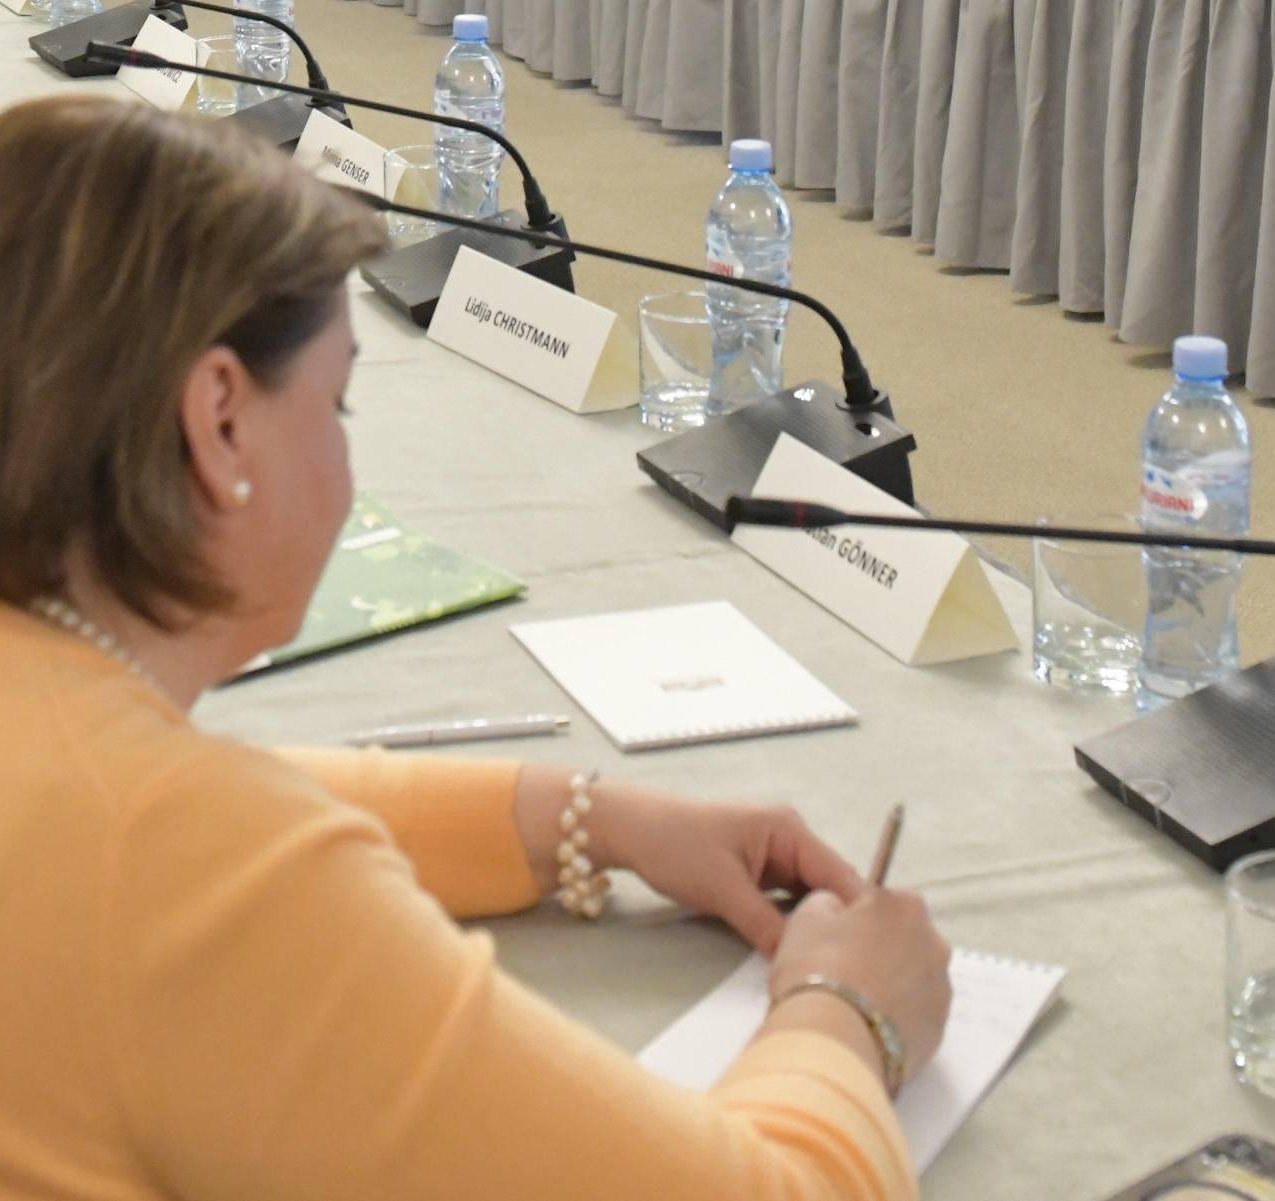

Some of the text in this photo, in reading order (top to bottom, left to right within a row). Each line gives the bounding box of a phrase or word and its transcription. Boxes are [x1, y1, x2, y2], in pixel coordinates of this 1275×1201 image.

[341, 158, 370, 185] GENSER
[465, 296, 570, 359] Lidija CHRISTMANN
[837, 537, 898, 589] GÖNNER
